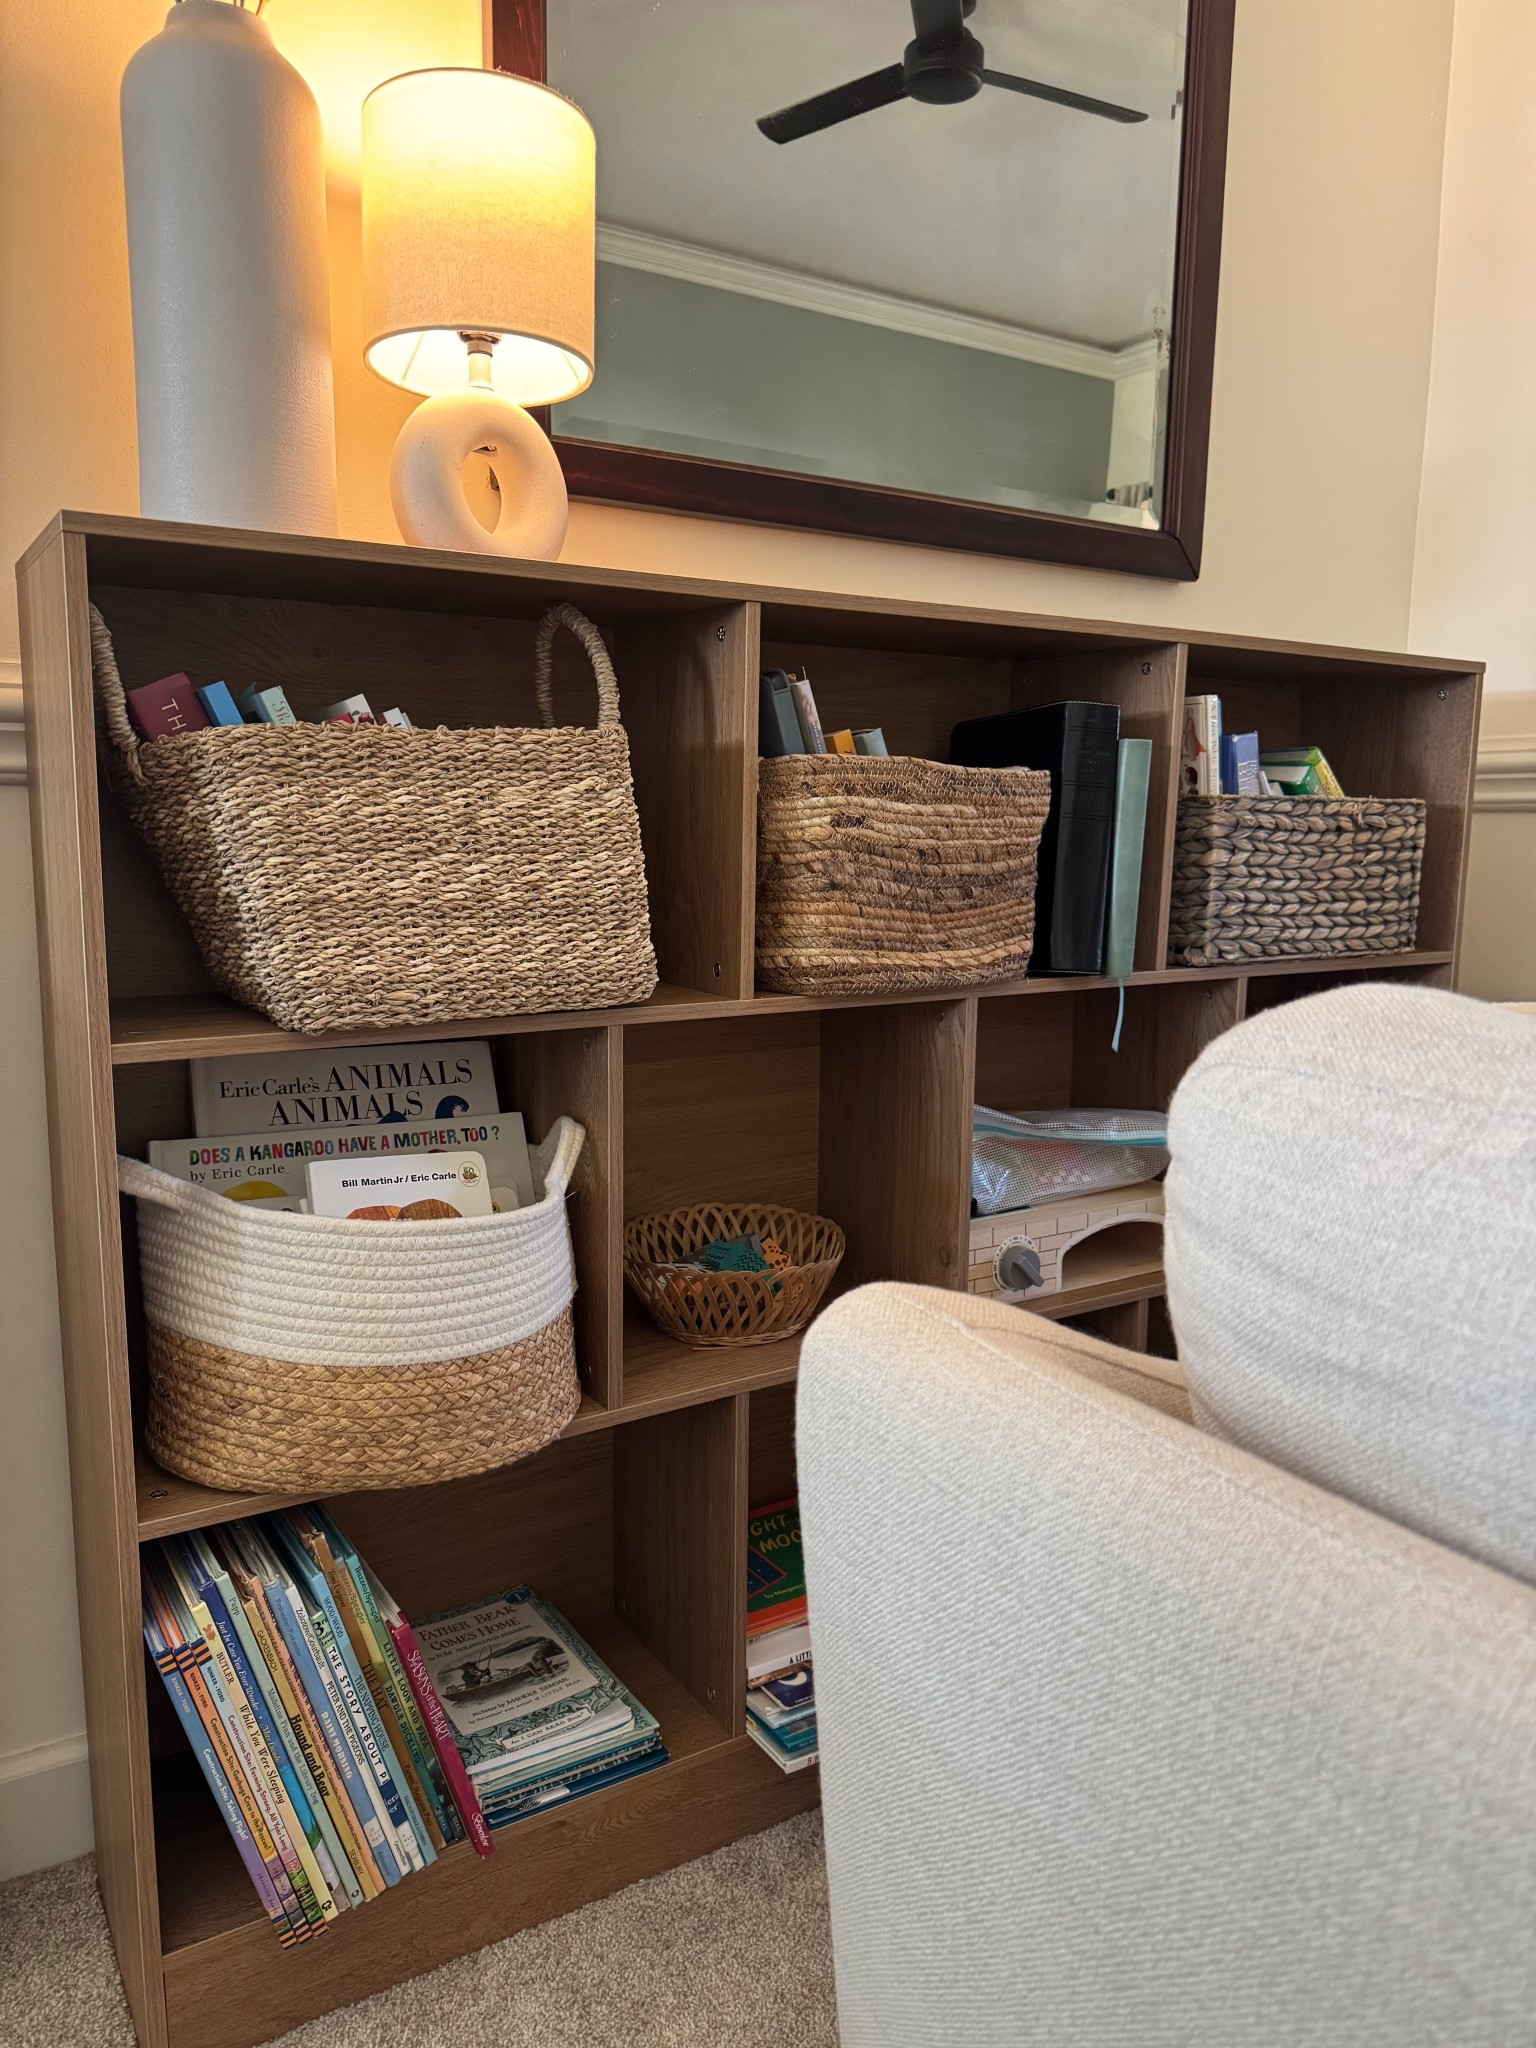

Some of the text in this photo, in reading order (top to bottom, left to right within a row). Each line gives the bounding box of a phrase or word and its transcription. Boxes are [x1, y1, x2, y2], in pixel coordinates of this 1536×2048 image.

[162, 698, 186, 731] TH
[220, 1058, 473, 1099] Eric Carle's ANIMALS
[268, 1090, 423, 1126] ANIMALS
[189, 1147, 230, 1166] DOES
[234, 1146, 246, 1161] A
[249, 1138, 335, 1160] KANGAROO
[338, 1135, 377, 1154] HAVE
[380, 1134, 391, 1149] A
[393, 1129, 461, 1149] MOTHER,
[461, 1125, 488, 1142] TOO
[189, 1163, 285, 1183] by Eric Carle
[341, 1178, 359, 1188] Bill
[360, 1176, 394, 1187] Martin
[411, 1172, 430, 1183] Eric
[431, 1170, 457, 1181] Carle
[750, 1513, 787, 1536] GHT
[760, 1529, 802, 1553] MOO
[229, 1596, 241, 1617] Papp
[339, 1567, 365, 1625] Buzzeo/Spengler
[354, 1566, 381, 1624] Buzzeo/Spengler
[323, 1596, 344, 1638] WOOD/WOOD
[419, 1605, 517, 1641] FATHER BEAR
[430, 1617, 521, 1651] COMES HOME
[216, 1619, 260, 1711] Just In Case You Ever Wonder
[216, 1651, 235, 1684] BUTLER
[256, 1629, 278, 1672] GACKENBACH
[789, 1650, 812, 1665] A LITT
[172, 1676, 191, 1714] RINKER FORD
[189, 1671, 208, 1709] RINKER FORD
[207, 1666, 225, 1702] RINKER FORD
[361, 1660, 388, 1711] THE HAT
[383, 1641, 429, 1749] LITTLE LOON AND PAPA
[406, 1649, 434, 1696] SEASONS
[429, 1706, 451, 1742] HEART
[472, 1706, 497, 1717] pictures
[506, 1690, 538, 1705] MAURICE
[540, 1677, 570, 1691] SENDAK
[326, 1680, 365, 1765] PETER AND THE PIGEONS
[328, 1646, 389, 1784] THE STORY ABOUT PI
[354, 1674, 390, 1752] THE NAPPING HOUSE
[385, 1684, 422, 1764] DAWDLE DUCKLING
[526, 1730, 543, 1738] CAN
[545, 1720, 565, 1731] READ
[239, 1703, 287, 1805] While You Were Sleeping
[267, 1687, 320, 1805] Madeline Finn and the Library Dog
[290, 1713, 331, 1798] Hound and Bear
[331, 1737, 354, 1779] MORNING
[203, 1747, 247, 1841] Construction Site: Taking Flight!
[210, 1717, 271, 1851] Construction Site: Garbage Crew to the Rescue!
[228, 1714, 288, 1851] Construction Site: Farming Strong, All Year Long
[438, 1815, 448, 1832] DIAL
[452, 1815, 462, 1832] DIAL
[349, 1848, 364, 1875] SEABURY
